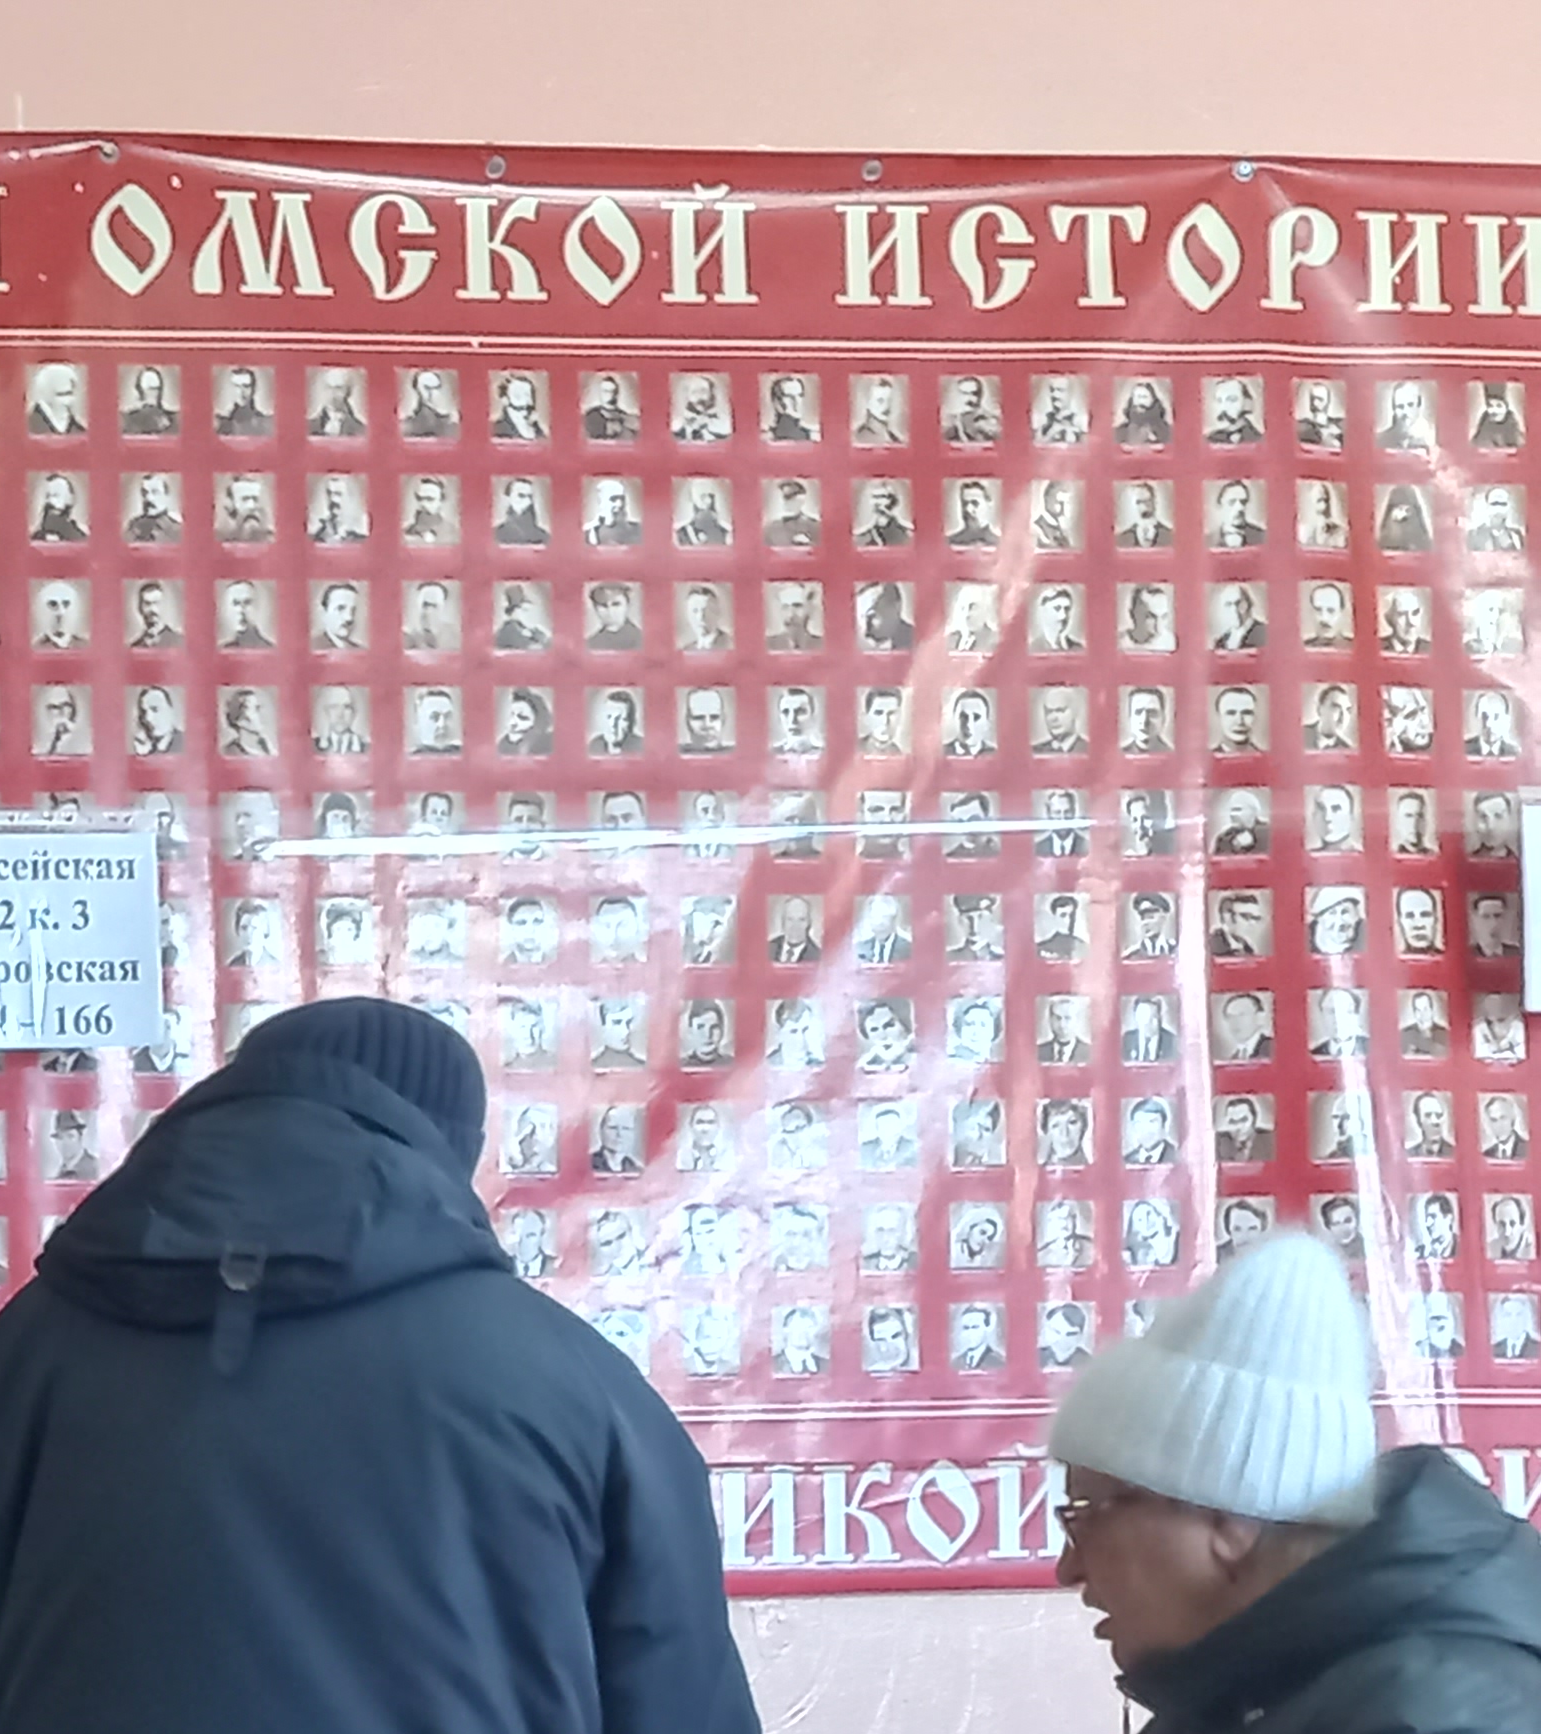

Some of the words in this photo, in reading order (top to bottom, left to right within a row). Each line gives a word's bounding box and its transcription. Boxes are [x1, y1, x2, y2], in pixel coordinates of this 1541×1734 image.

[90, 181, 760, 306] ОМСКОЙ
[834, 200, 1541, 316] ИСТОРИИ
[71, 899, 91, 931] 3
[54, 1004, 114, 1036] 166
[710, 1442, 1069, 1564] ИКОЙ
